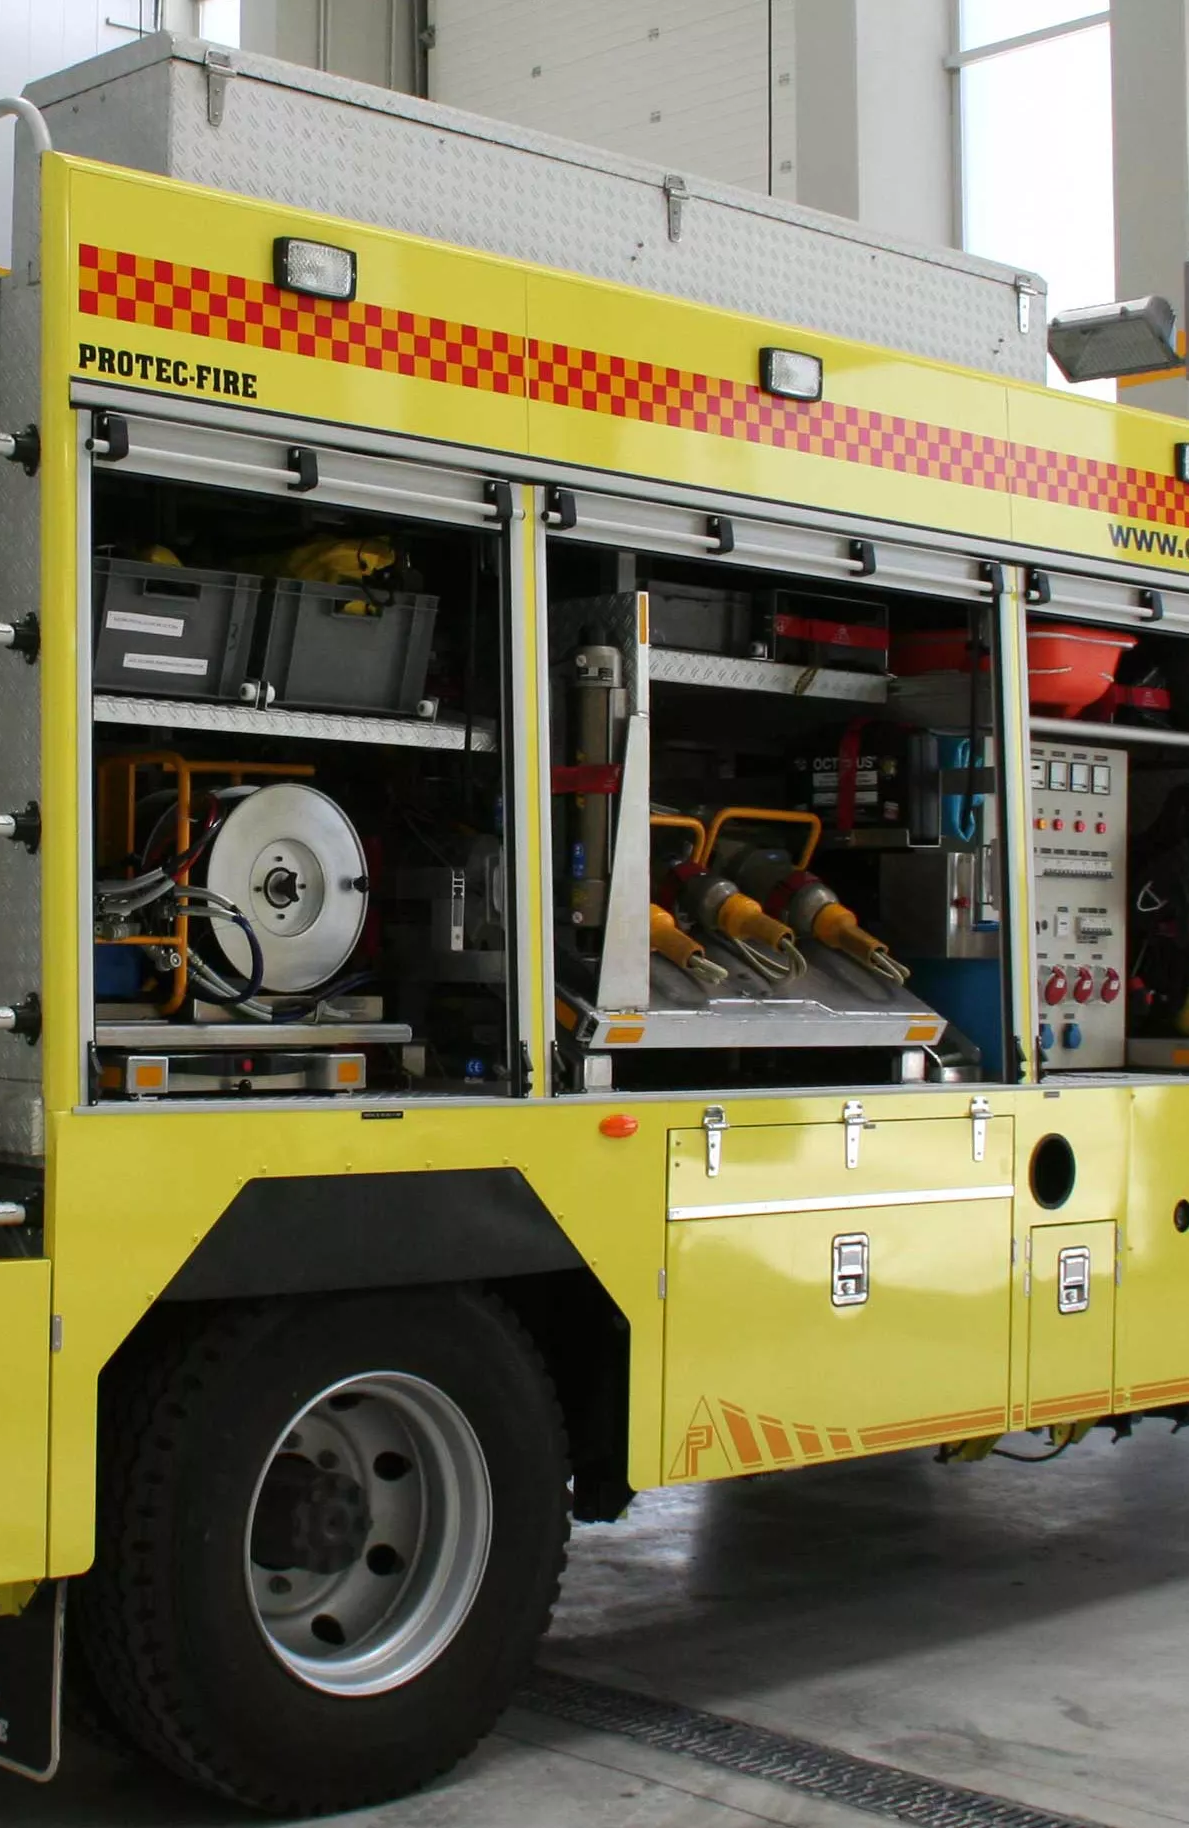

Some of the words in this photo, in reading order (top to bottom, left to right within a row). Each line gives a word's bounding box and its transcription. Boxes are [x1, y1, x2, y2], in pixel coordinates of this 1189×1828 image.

[78, 342, 258, 399] PROTEC-FIRE
[1107, 522, 1189, 560] www.
[813, 756, 874, 771] OCTUS
